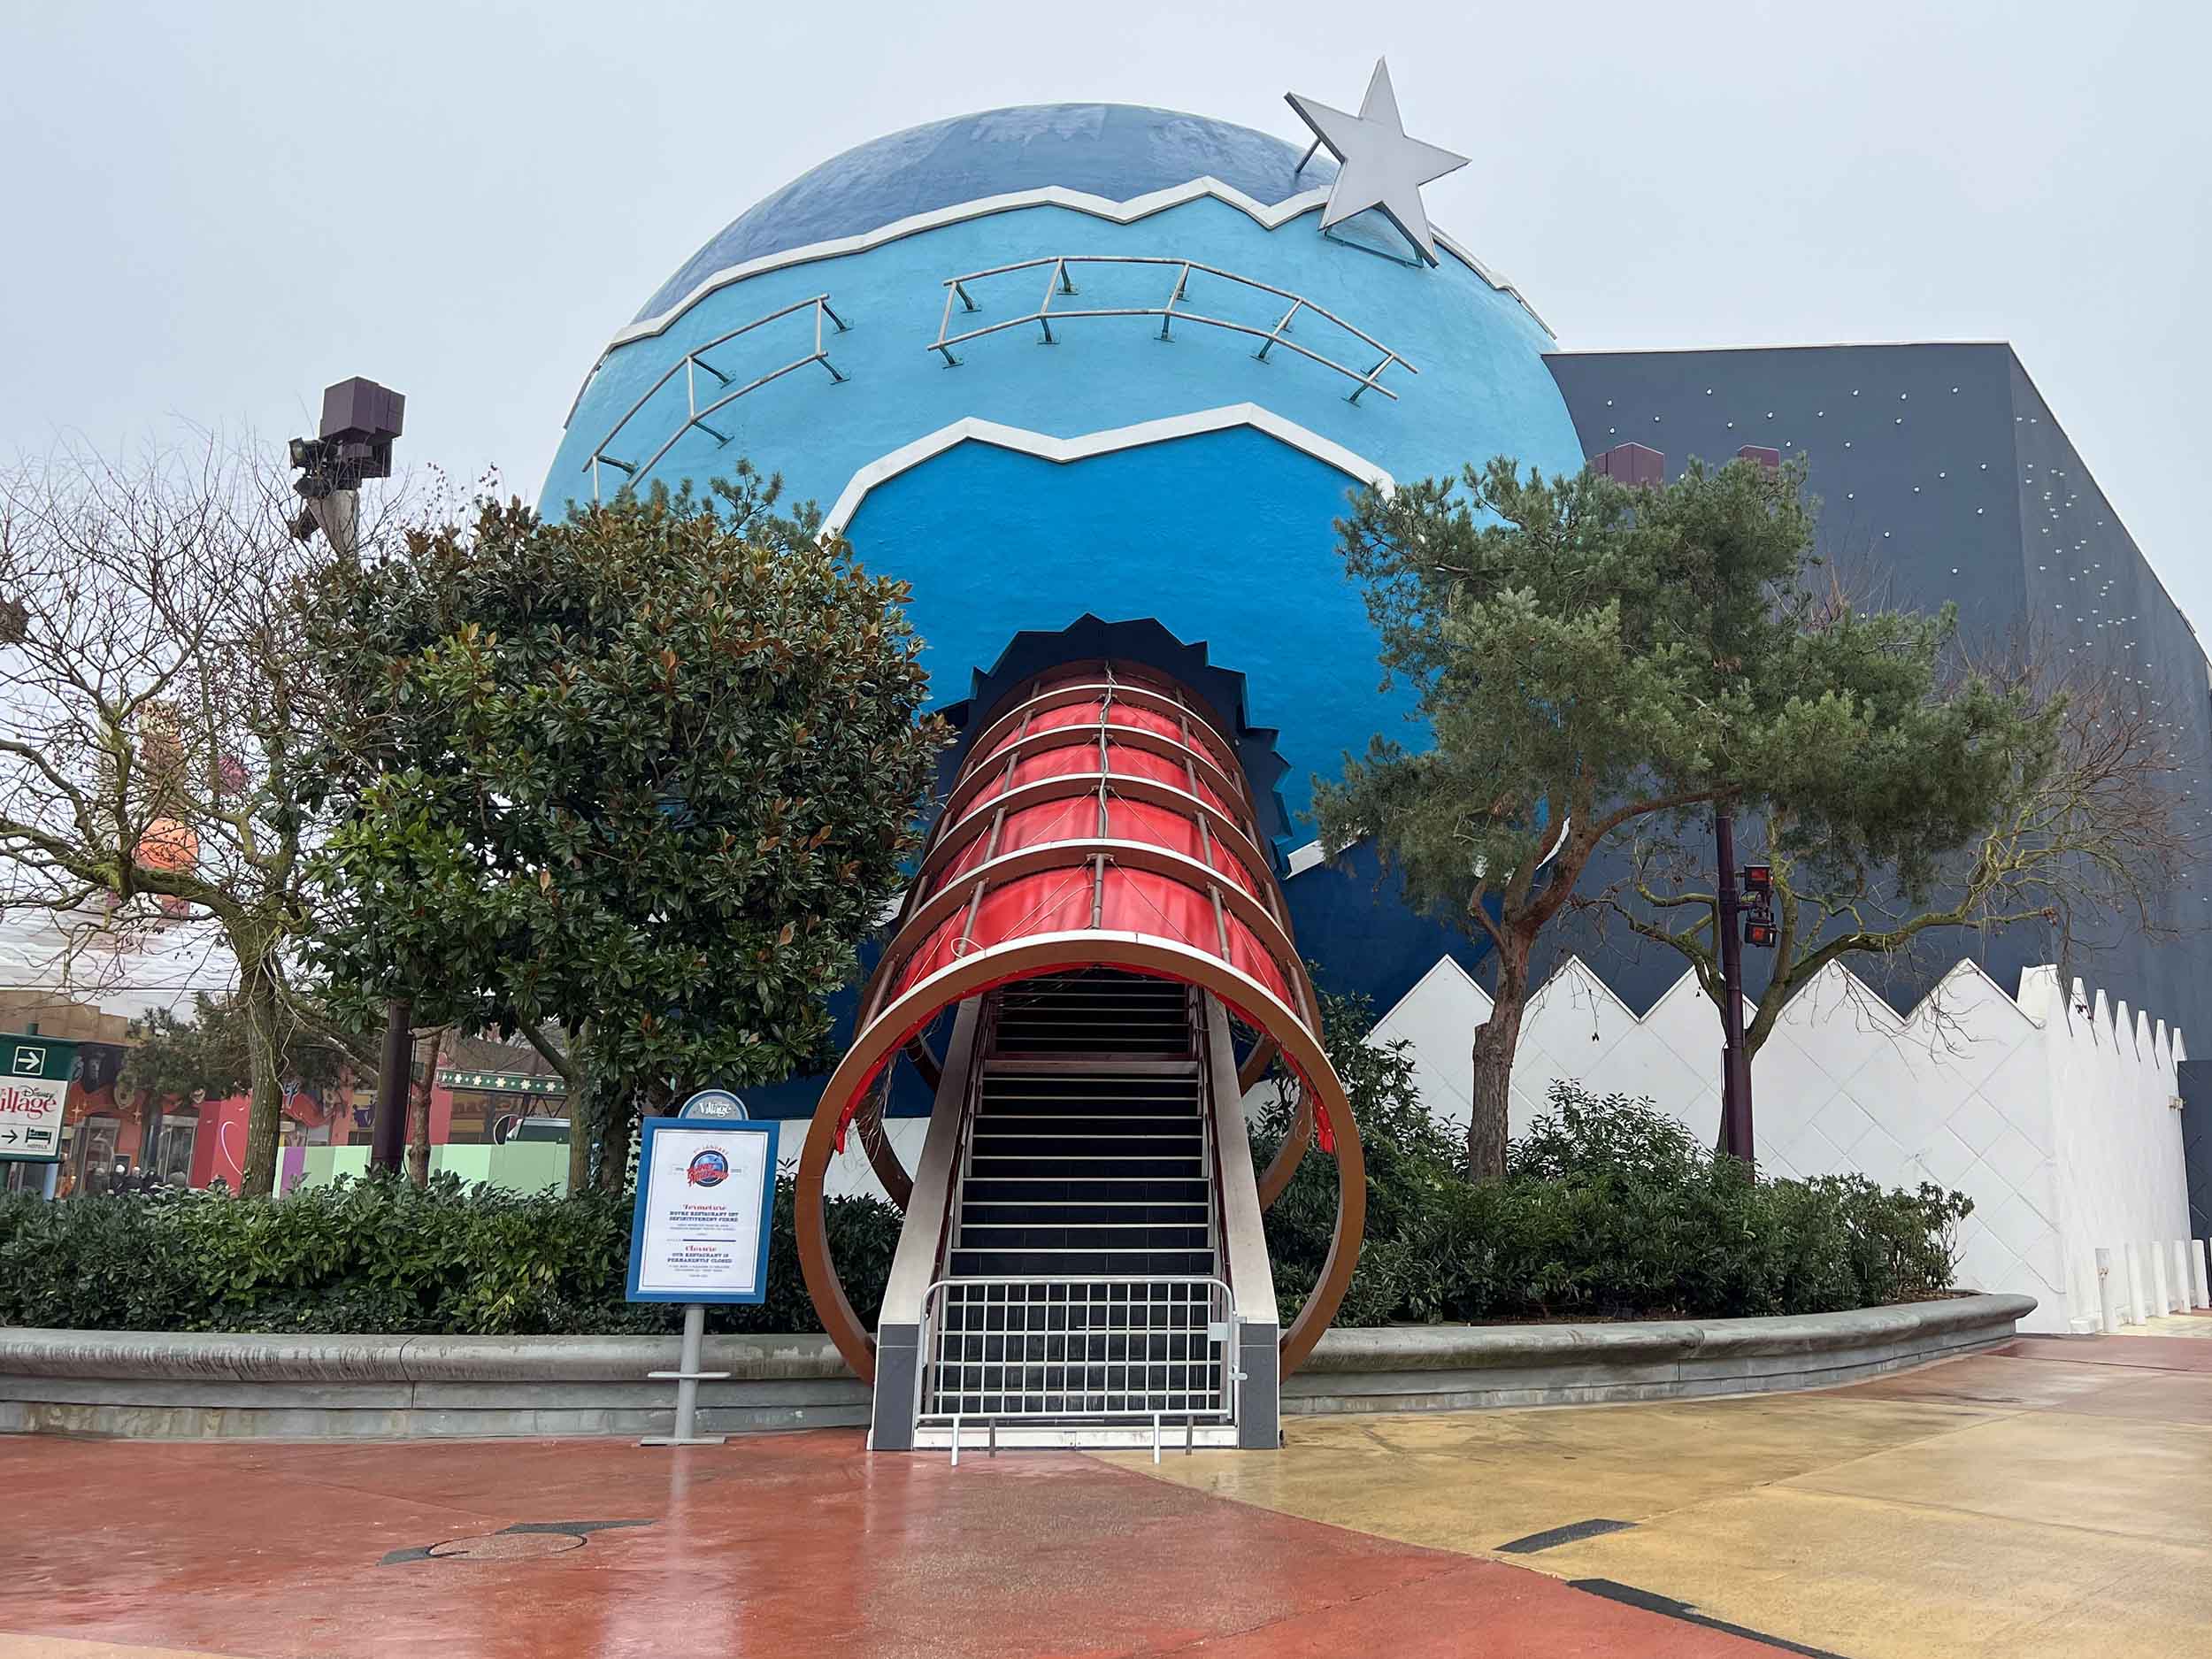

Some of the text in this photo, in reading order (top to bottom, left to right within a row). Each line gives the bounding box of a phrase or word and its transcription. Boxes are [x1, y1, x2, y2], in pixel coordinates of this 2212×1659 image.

[20, 1085, 56, 1102] Disney
[0, 1087, 58, 1120] illage
[699, 1102, 732, 1118] Village
